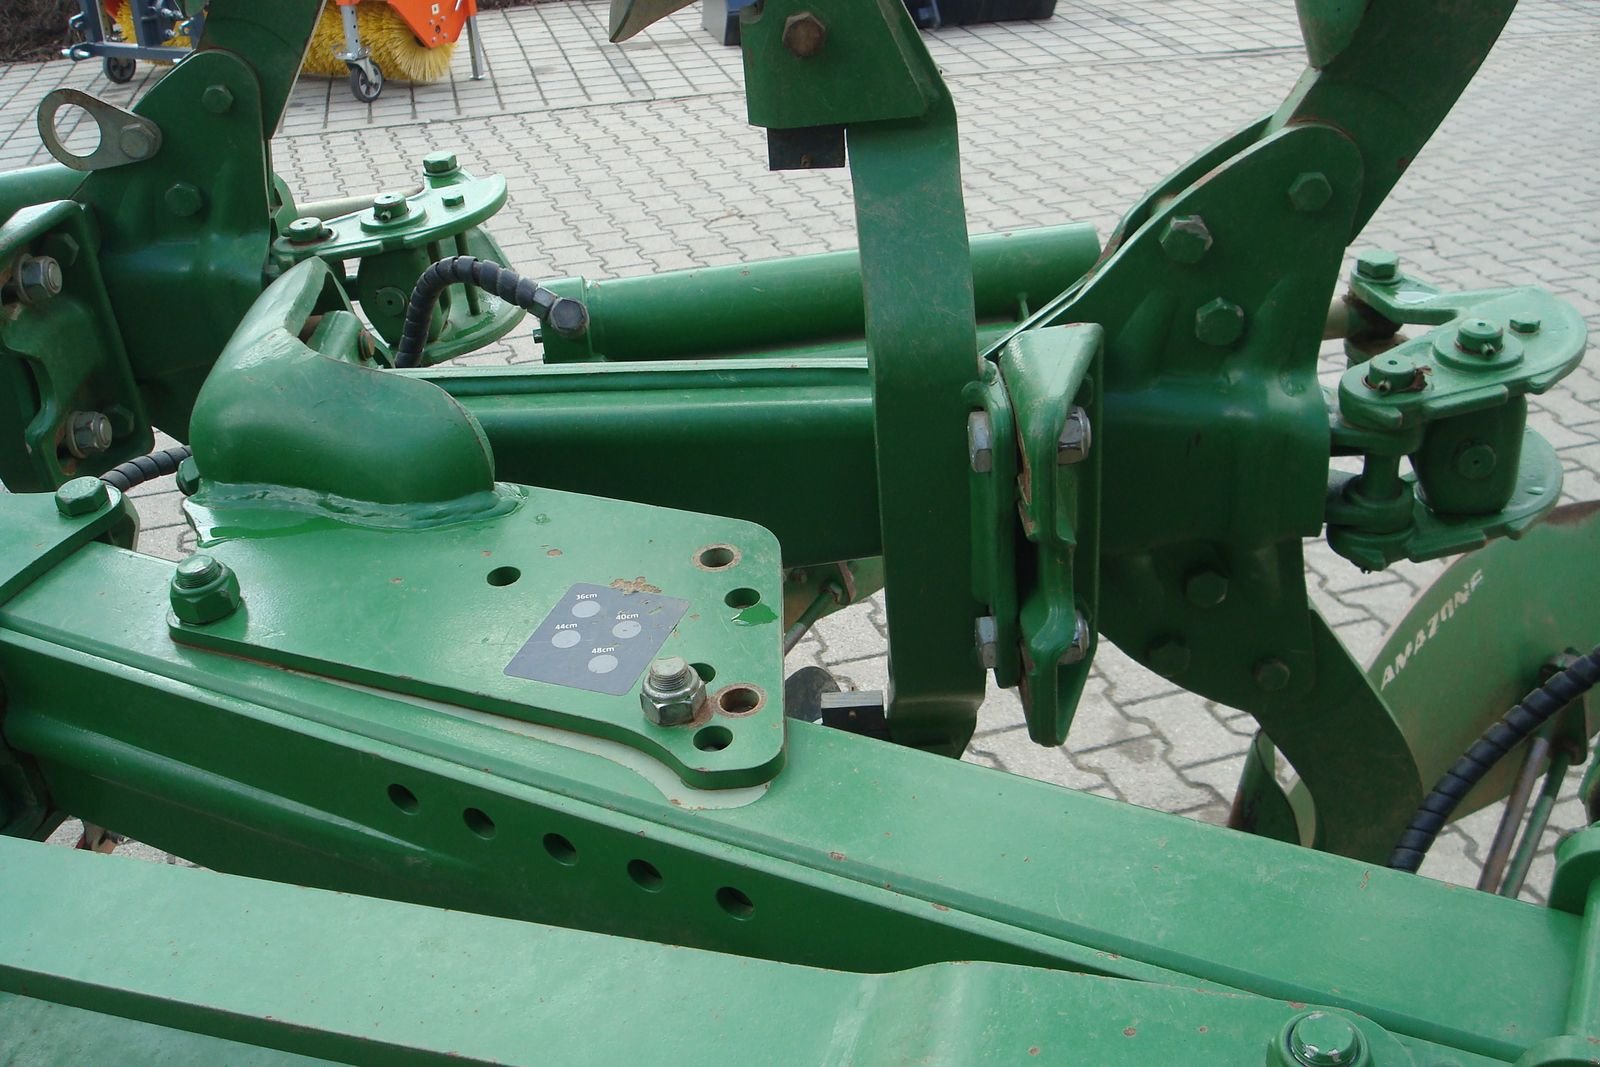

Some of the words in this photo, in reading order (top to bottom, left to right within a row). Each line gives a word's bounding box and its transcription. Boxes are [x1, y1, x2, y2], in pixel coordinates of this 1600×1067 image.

[575, 592, 598, 601] 36cm
[615, 612, 639, 621] 40cm
[554, 622, 578, 631] 44cm
[591, 646, 615, 655] 48cm
